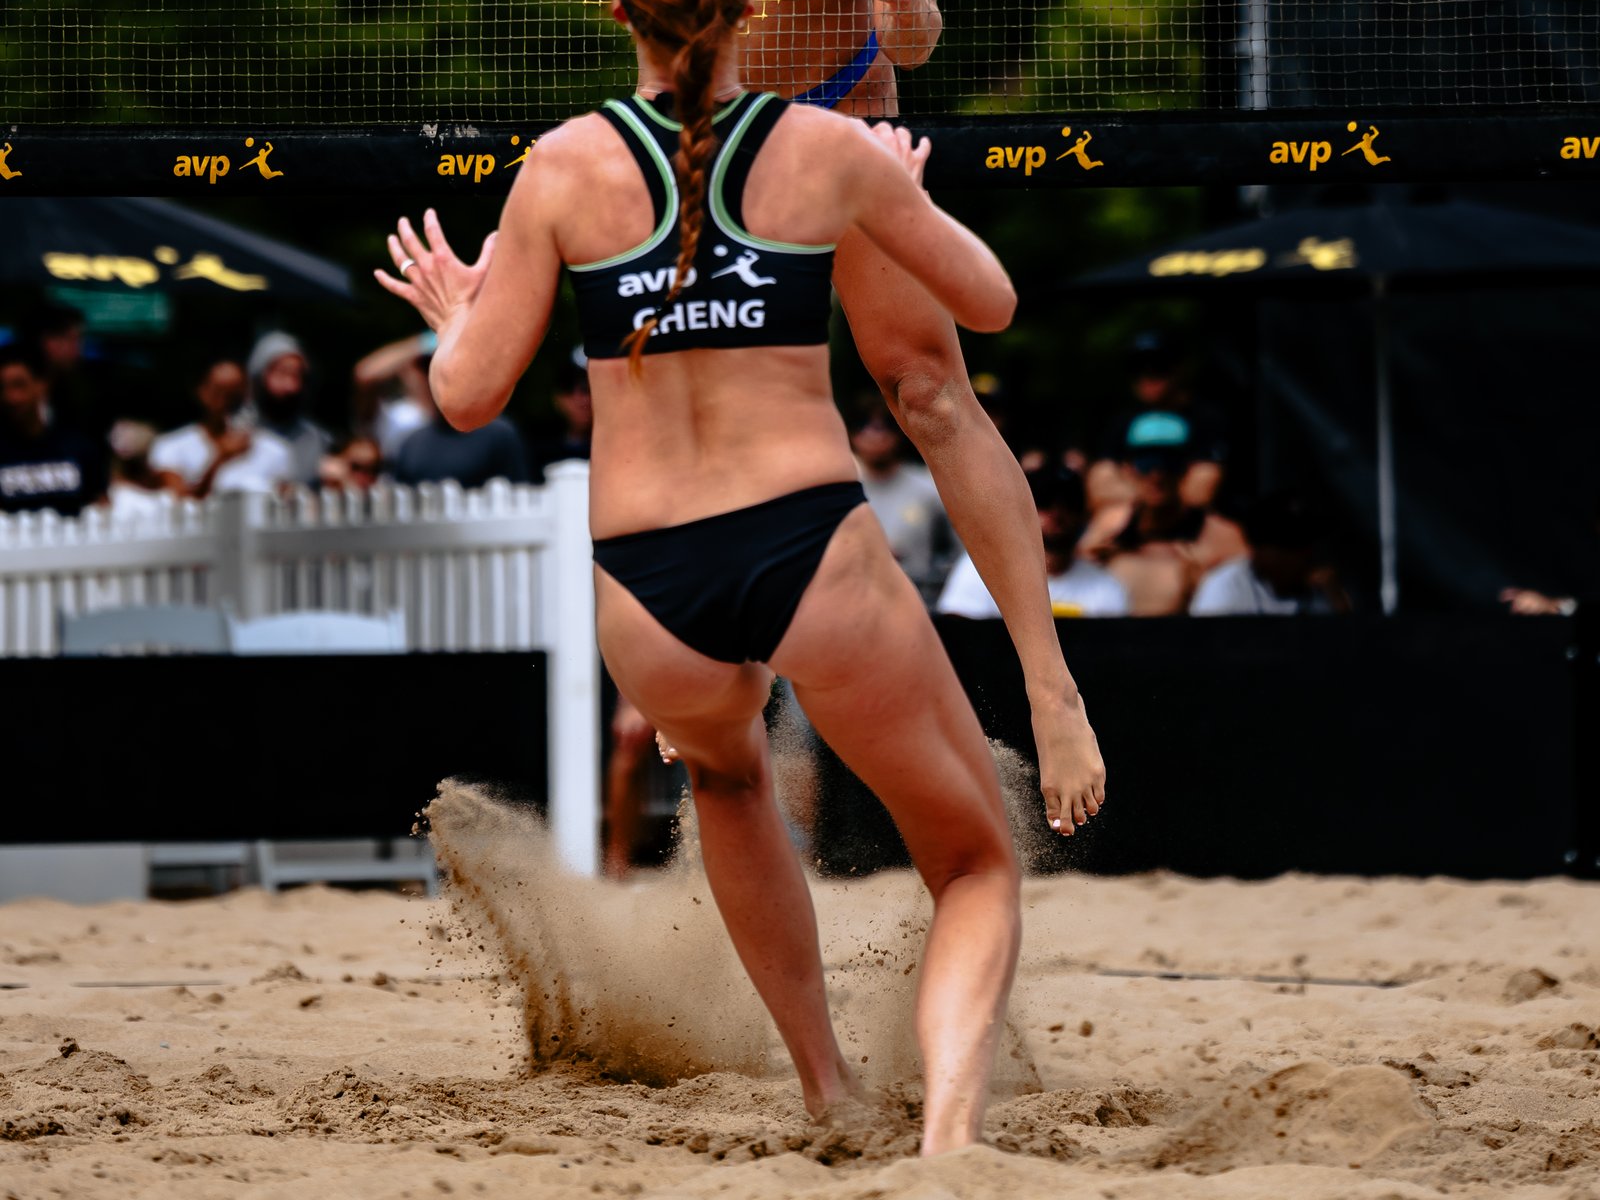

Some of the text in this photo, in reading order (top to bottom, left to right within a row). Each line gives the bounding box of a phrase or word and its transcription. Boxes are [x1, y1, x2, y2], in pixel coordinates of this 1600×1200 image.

[173, 155, 231, 185] avp
[436, 153, 496, 183] avp
[985, 145, 1047, 176] avp
[1269, 140, 1332, 172] avp
[632, 299, 766, 336] CHENG
